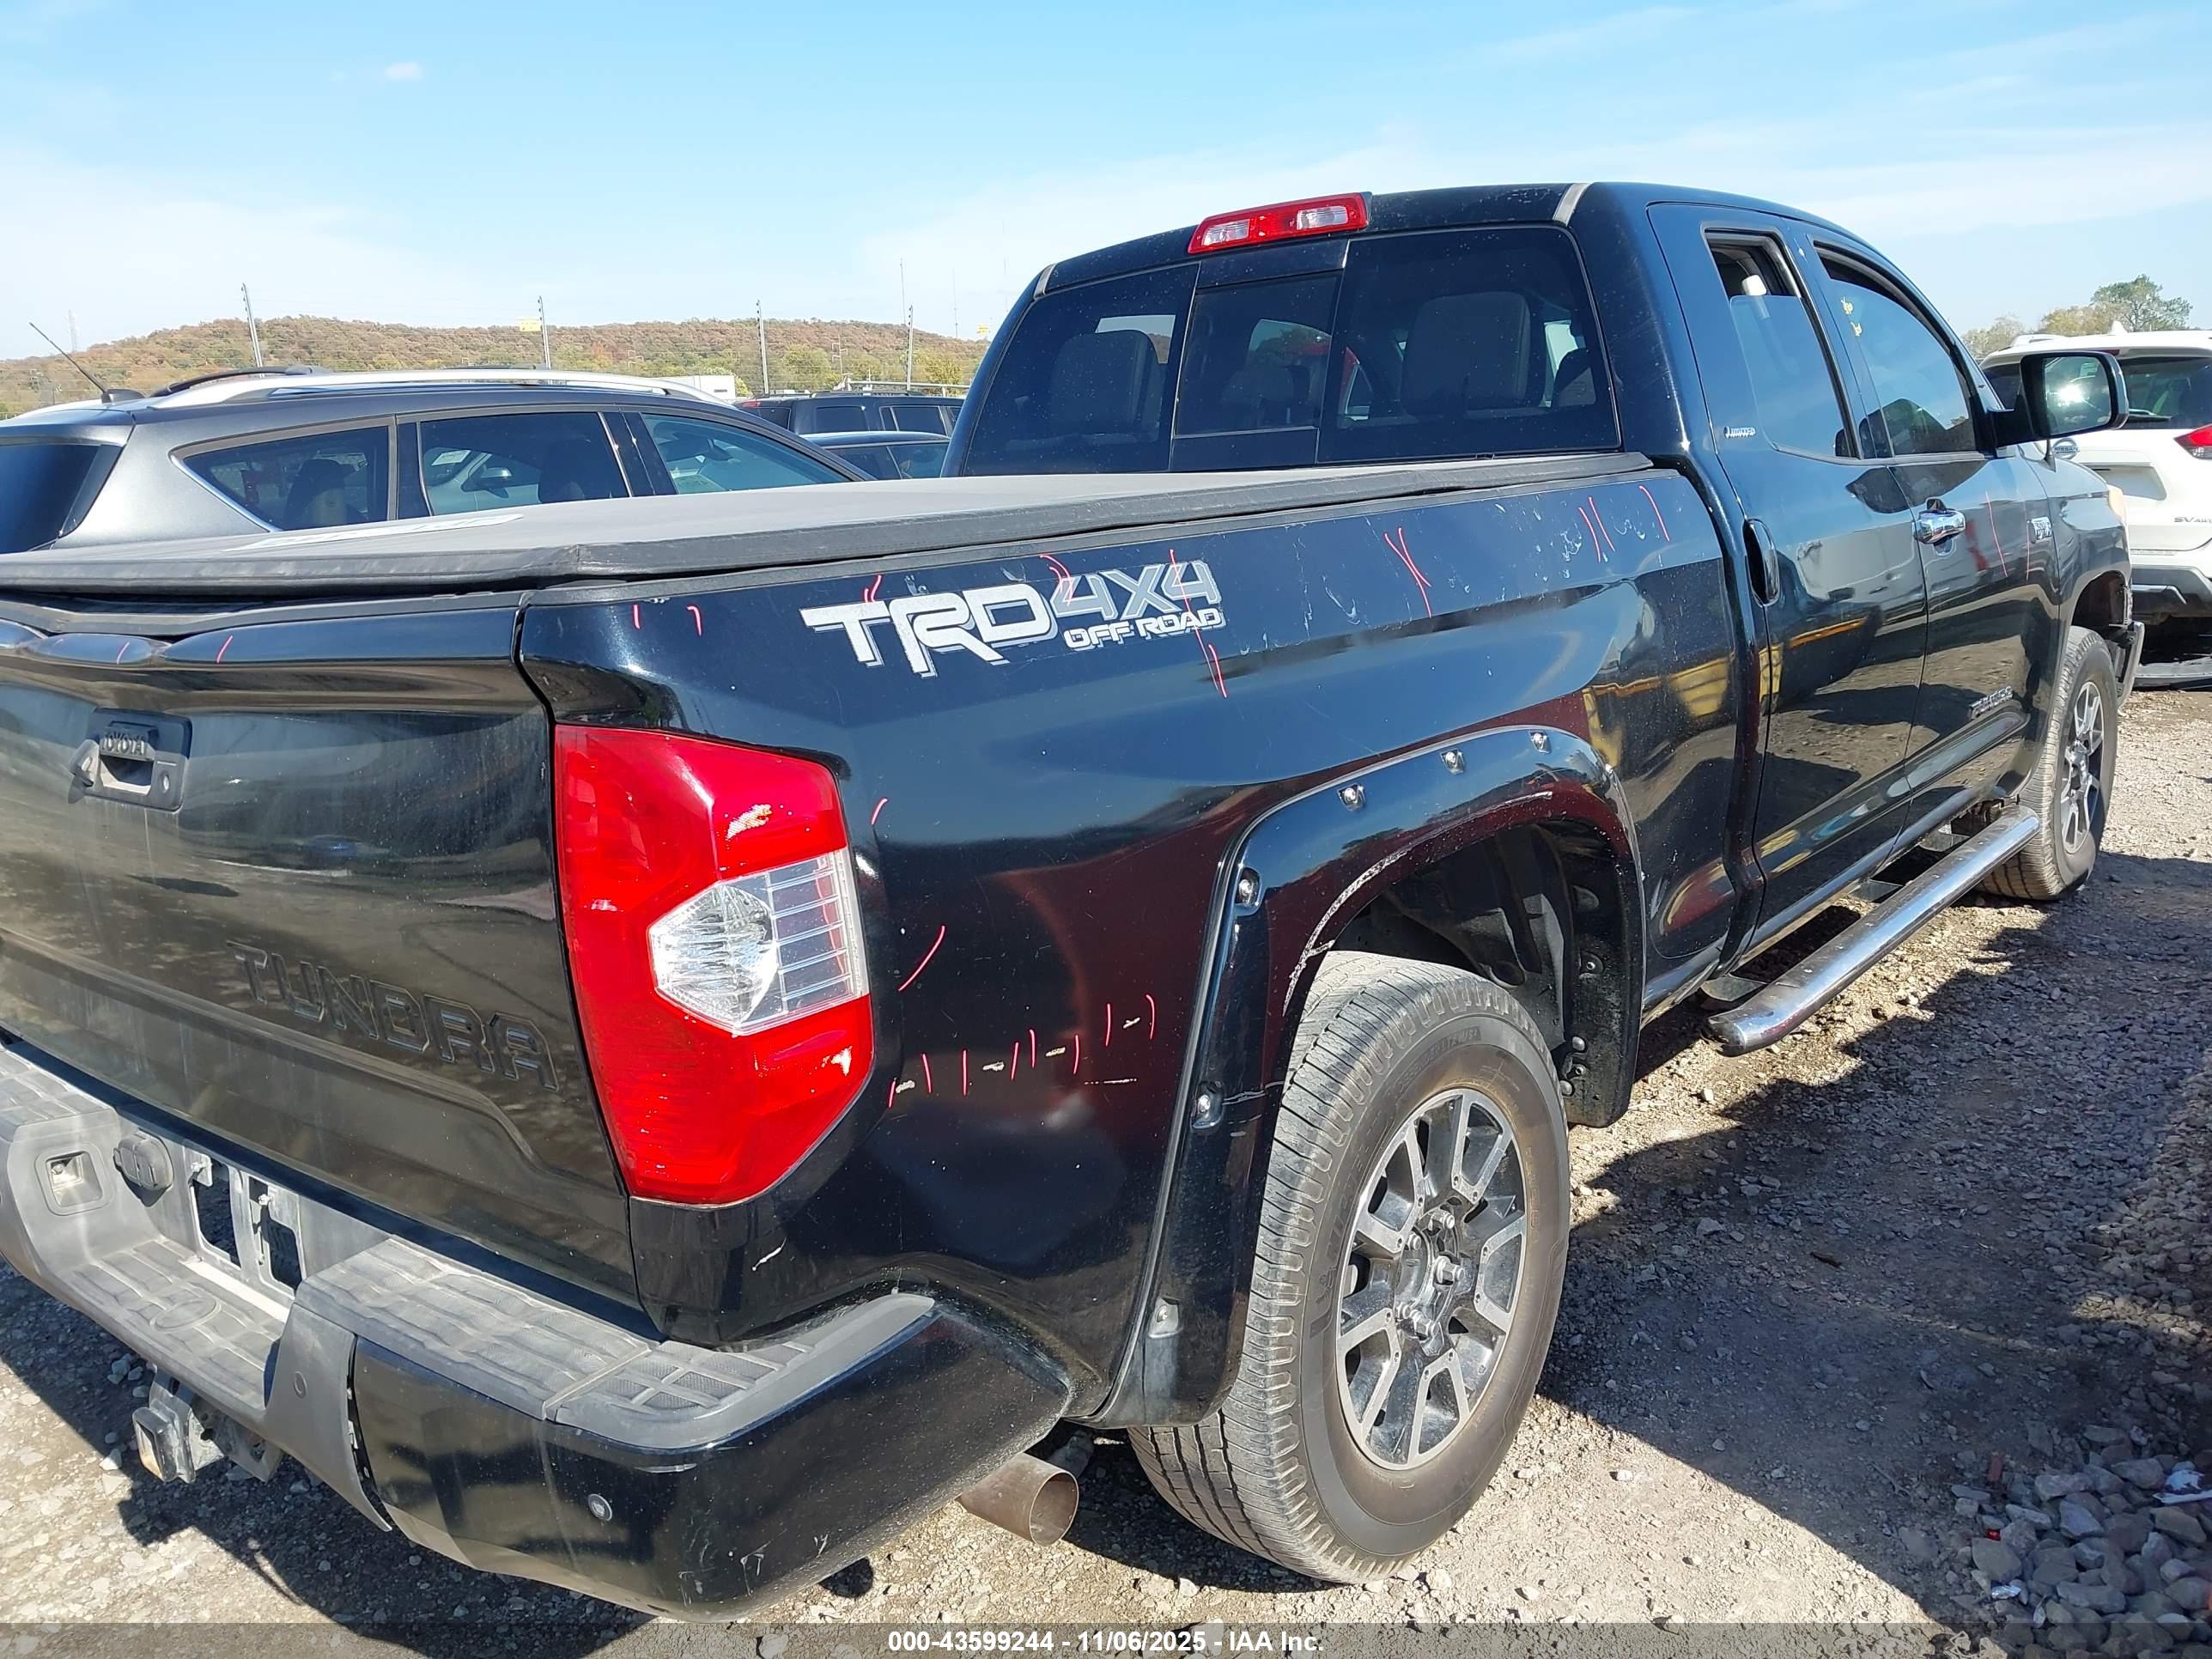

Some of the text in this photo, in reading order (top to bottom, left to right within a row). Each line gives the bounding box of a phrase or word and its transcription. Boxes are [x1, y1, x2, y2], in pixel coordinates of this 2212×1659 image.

[799, 583, 1058, 678] TRD
[1063, 607, 1227, 652] OFF ROAD
[226, 940, 561, 1093] TUNDRA
